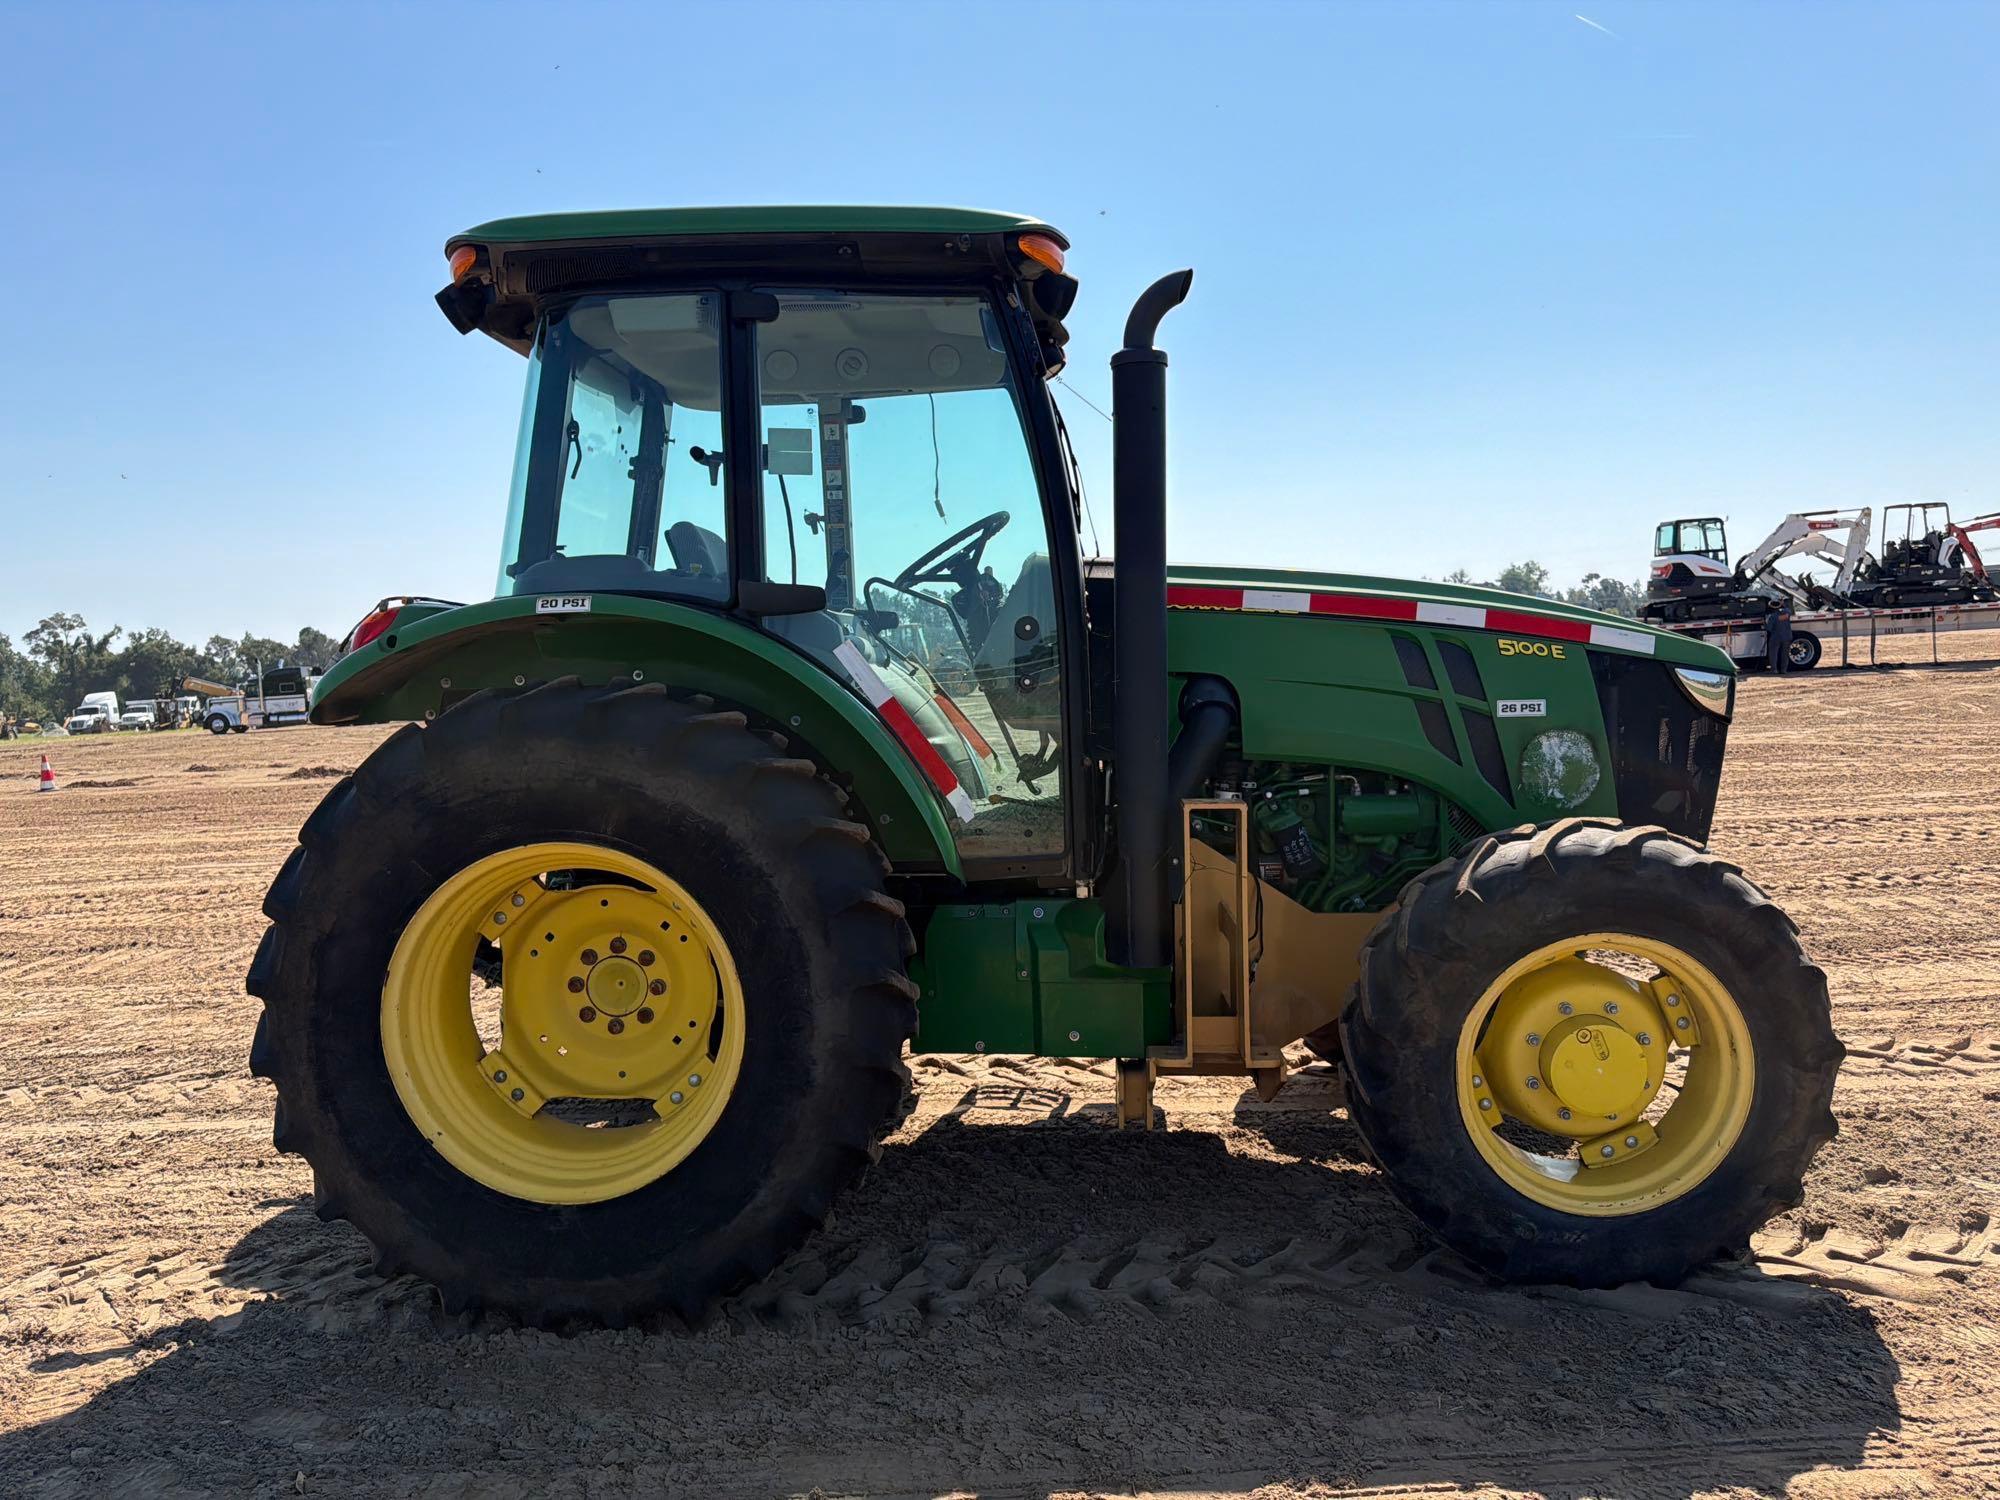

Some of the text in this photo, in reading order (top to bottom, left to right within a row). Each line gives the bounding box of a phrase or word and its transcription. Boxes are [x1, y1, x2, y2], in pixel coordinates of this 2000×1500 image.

[541, 598, 586, 608] 20 PSI
[1501, 703, 1542, 713] 26 PSI
